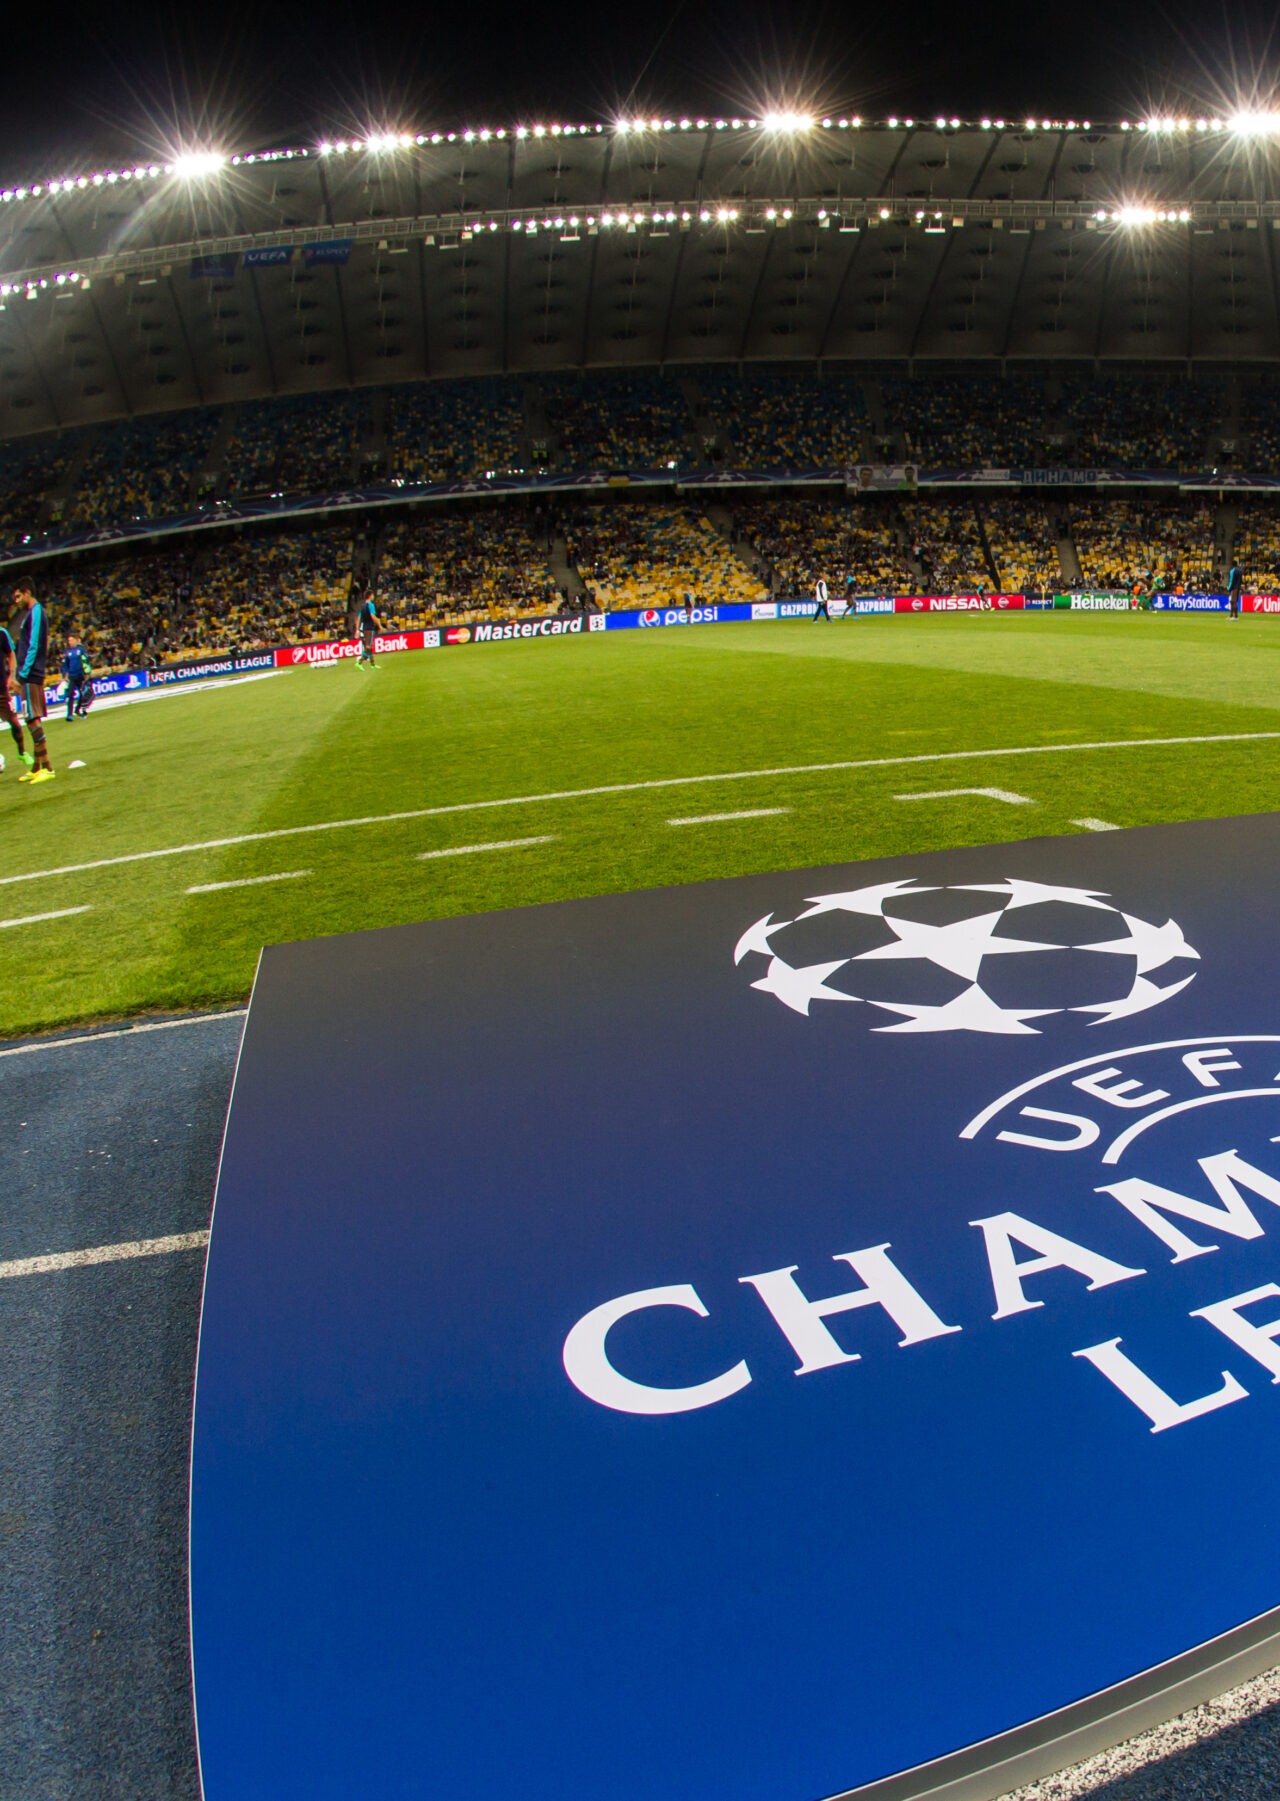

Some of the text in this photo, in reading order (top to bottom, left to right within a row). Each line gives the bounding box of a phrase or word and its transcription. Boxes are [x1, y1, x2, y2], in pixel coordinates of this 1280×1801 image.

[1070, 594, 1129, 610] Heineken
[1168, 596, 1220, 611] PlayStation
[664, 606, 718, 626] pepsi
[474, 616, 582, 643] MasterCard
[307, 636, 408, 663] UniCred Bank
[177, 660, 234, 679] CHAMPIONS
[235, 654, 273, 670] LEAGUE
